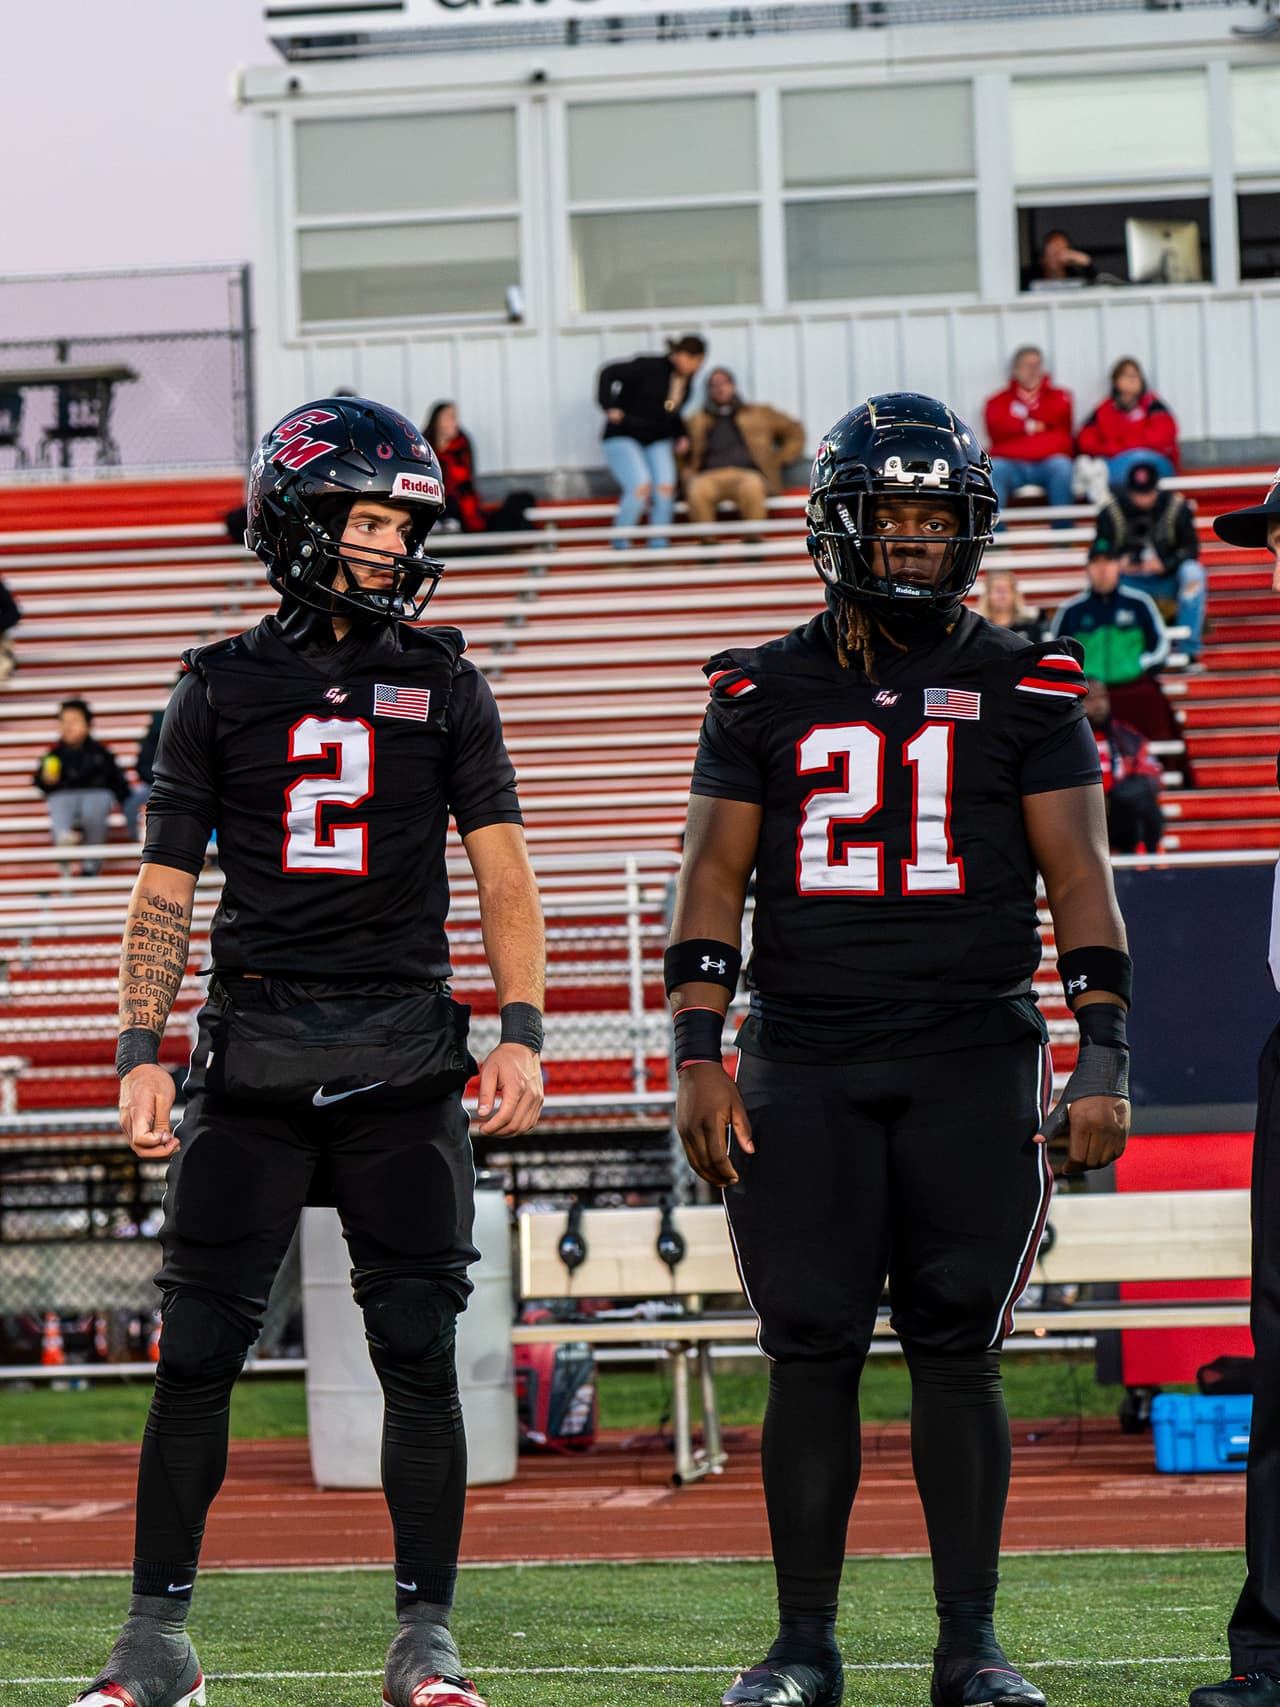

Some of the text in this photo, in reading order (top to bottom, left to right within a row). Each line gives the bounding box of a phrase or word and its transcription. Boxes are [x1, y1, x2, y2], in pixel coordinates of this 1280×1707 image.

[401, 477, 440, 497] Riddell
[325, 687, 347, 704] GM
[875, 690, 899, 707] GM
[282, 714, 375, 876] 2
[796, 720, 966, 897] 21
[151, 895, 184, 918] God
[138, 941, 173, 956] accept
[129, 985, 138, 994] to
